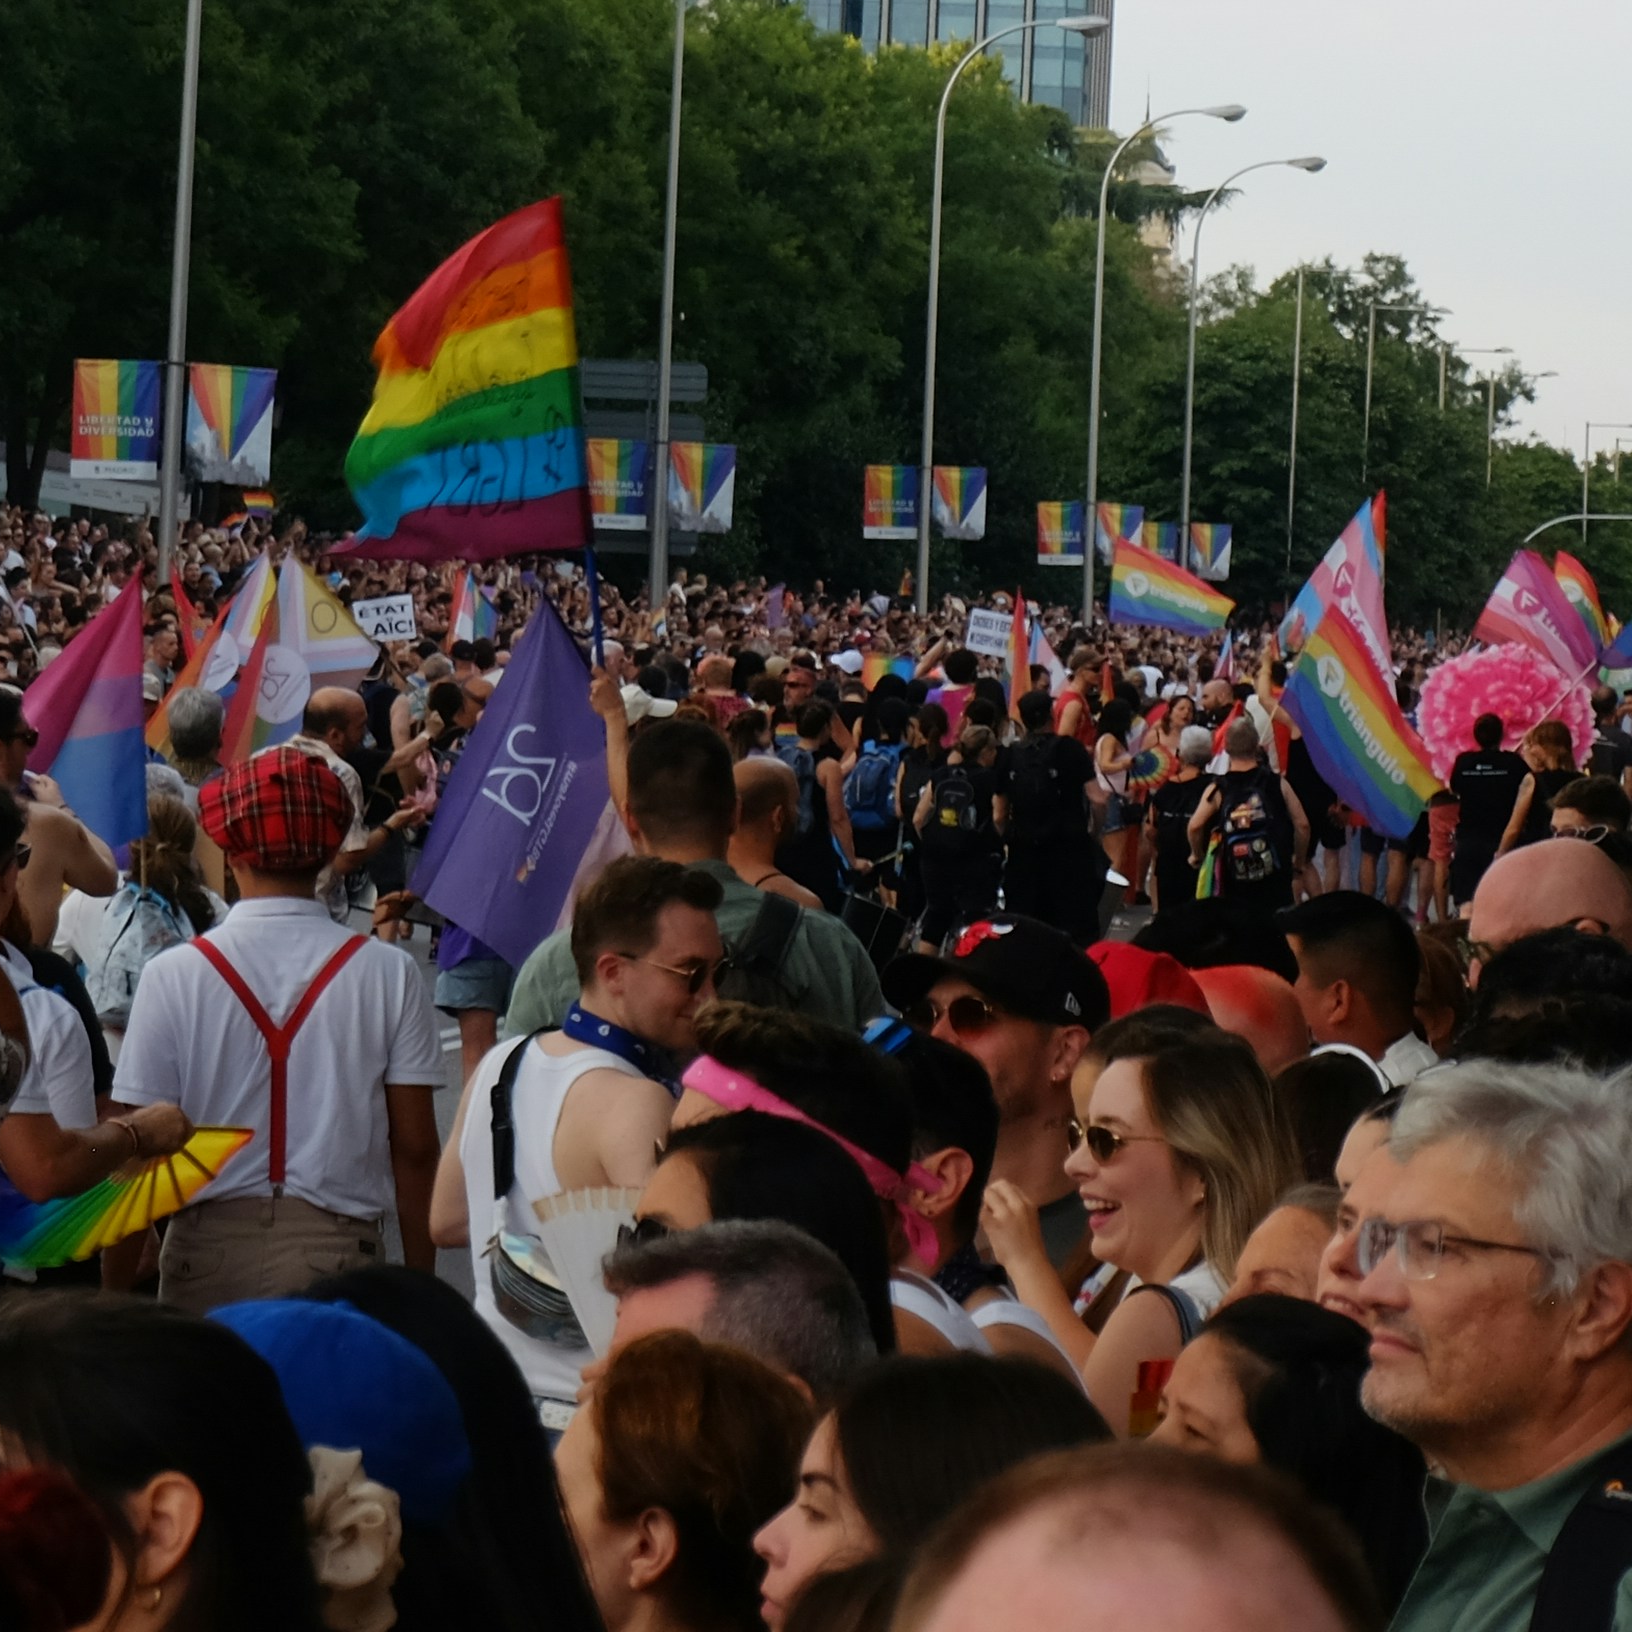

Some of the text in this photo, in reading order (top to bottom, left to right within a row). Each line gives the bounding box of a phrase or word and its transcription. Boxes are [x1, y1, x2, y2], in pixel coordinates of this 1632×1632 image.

[79, 415, 141, 426] LIBERTAD
[79, 425, 155, 437] DIVERSIDAD
[373, 616, 414, 636] AÏC!
